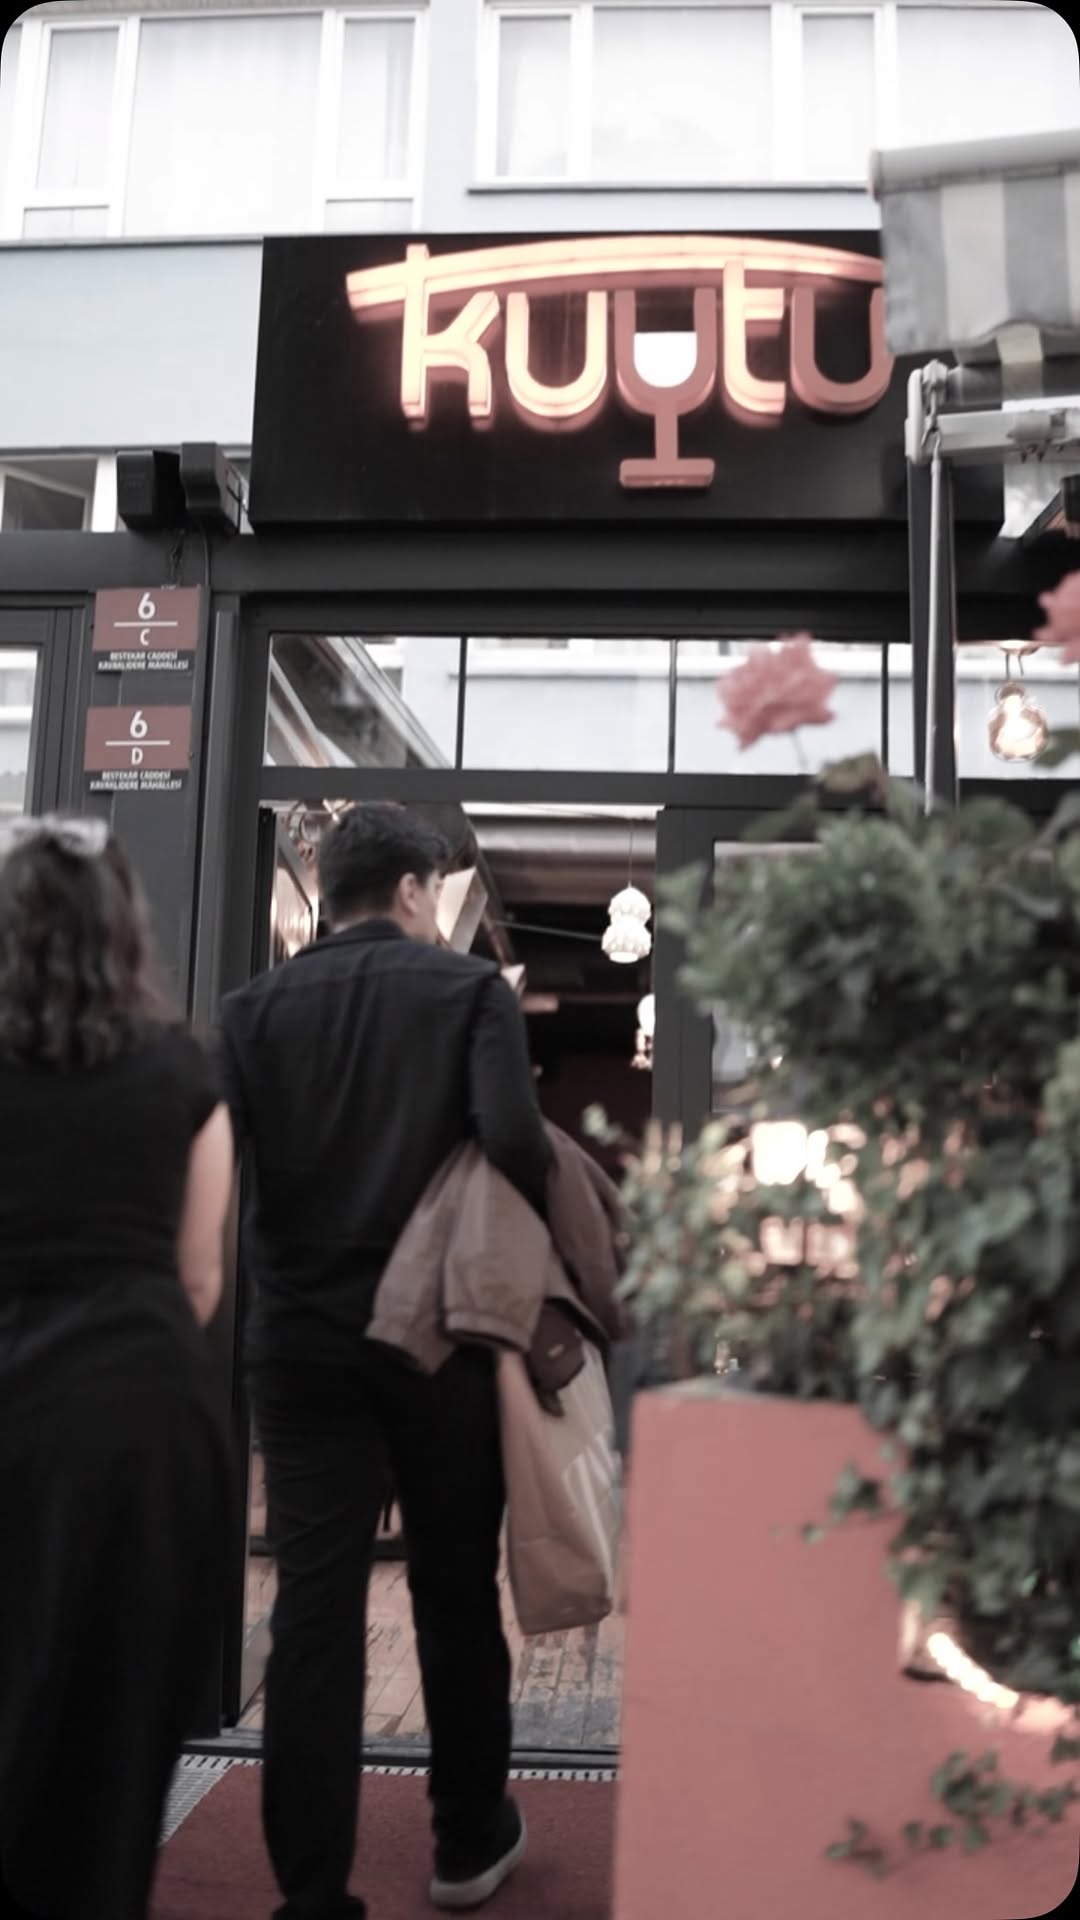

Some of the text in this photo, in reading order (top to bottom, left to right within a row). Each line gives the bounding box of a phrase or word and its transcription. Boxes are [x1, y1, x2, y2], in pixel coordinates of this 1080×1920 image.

[138, 592, 155, 619] 6
[140, 628, 150, 646] C
[129, 710, 148, 738] 6
[131, 747, 143, 766] D
